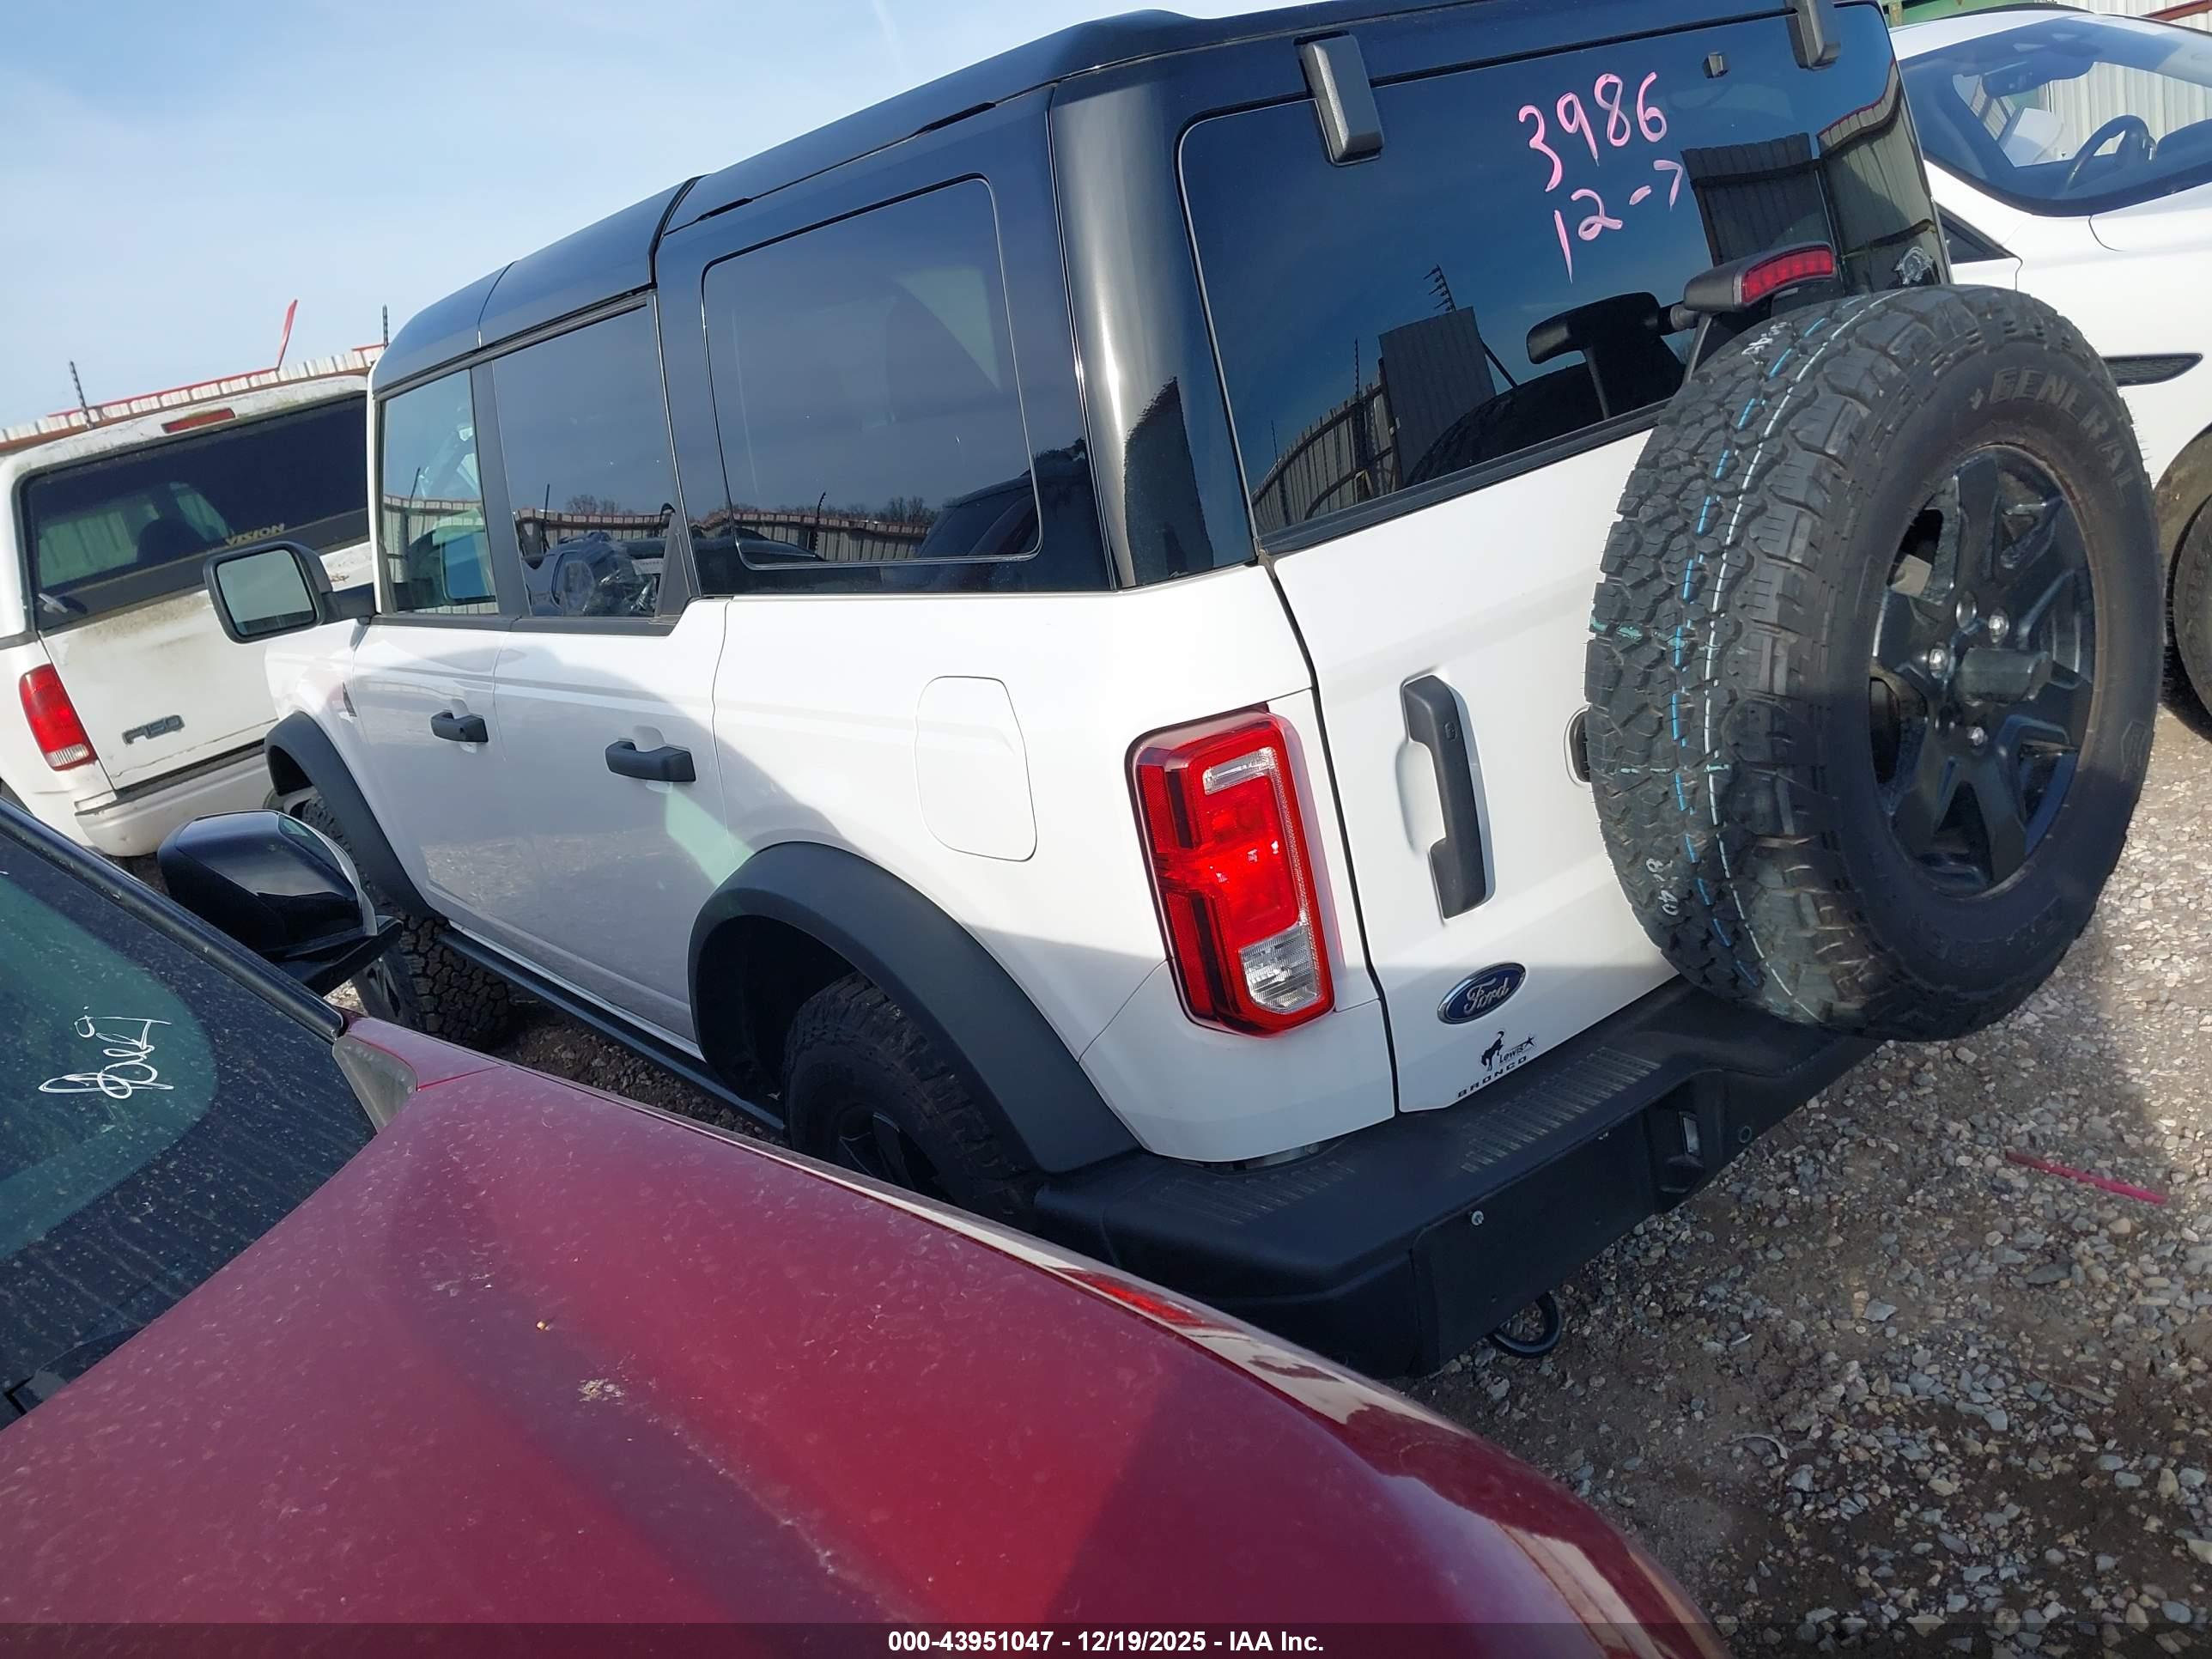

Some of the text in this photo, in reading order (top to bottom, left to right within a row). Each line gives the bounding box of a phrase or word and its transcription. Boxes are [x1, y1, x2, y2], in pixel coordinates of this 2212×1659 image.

[1518, 71, 1668, 192] 3986
[224, 522, 285, 547] VISION
[1463, 976, 1509, 1015] Ford
[1457, 1055, 1528, 1098] BRONCO
